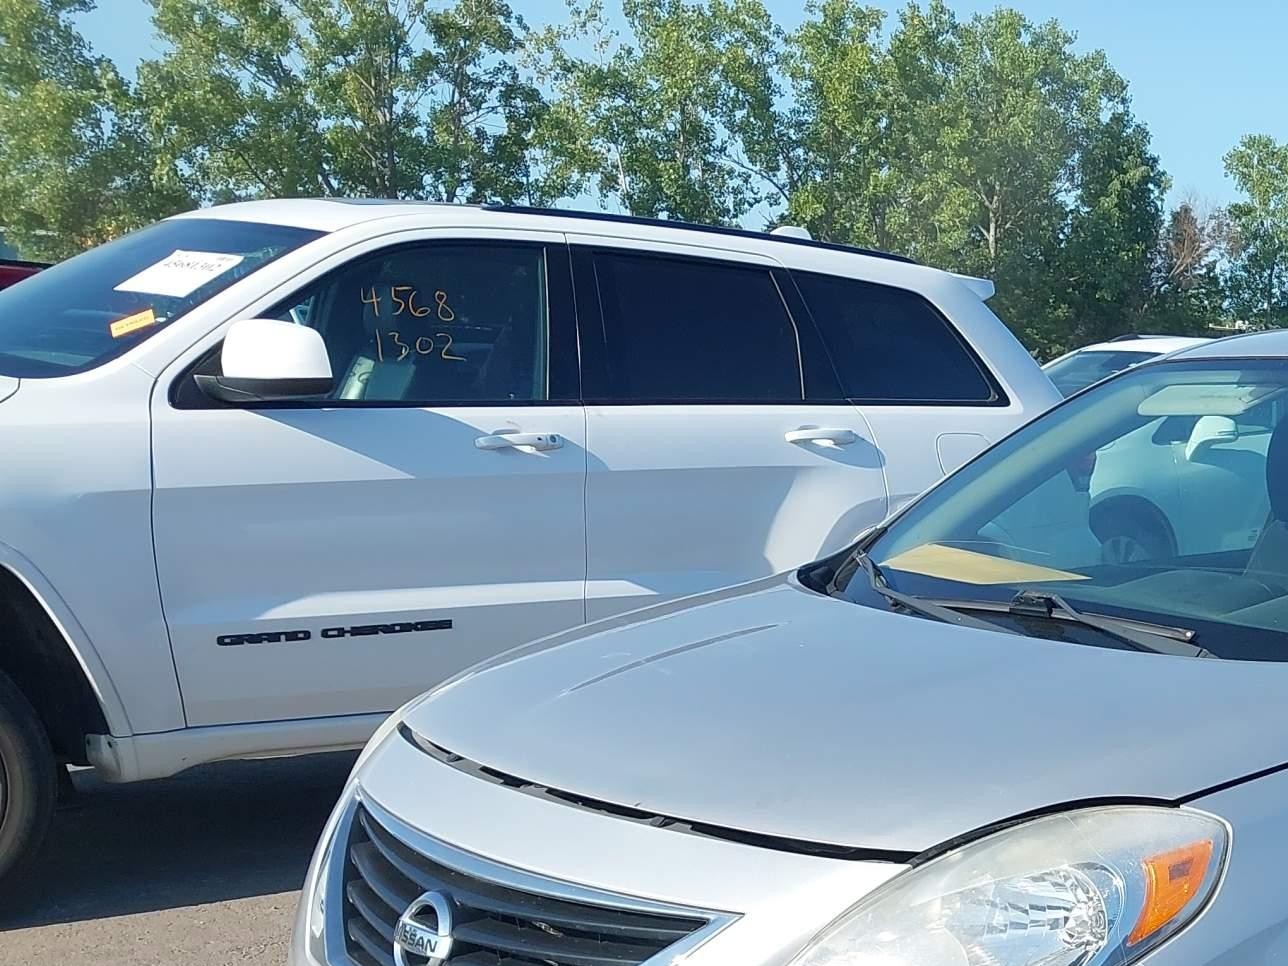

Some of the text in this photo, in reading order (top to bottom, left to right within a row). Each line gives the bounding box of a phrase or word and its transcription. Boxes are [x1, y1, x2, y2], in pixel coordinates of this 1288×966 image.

[360, 286, 455, 322] 4568
[375, 328, 467, 362] 1302
[216, 619, 452, 647] GRAND CHEROKEE
[399, 922, 438, 953] SSAN
